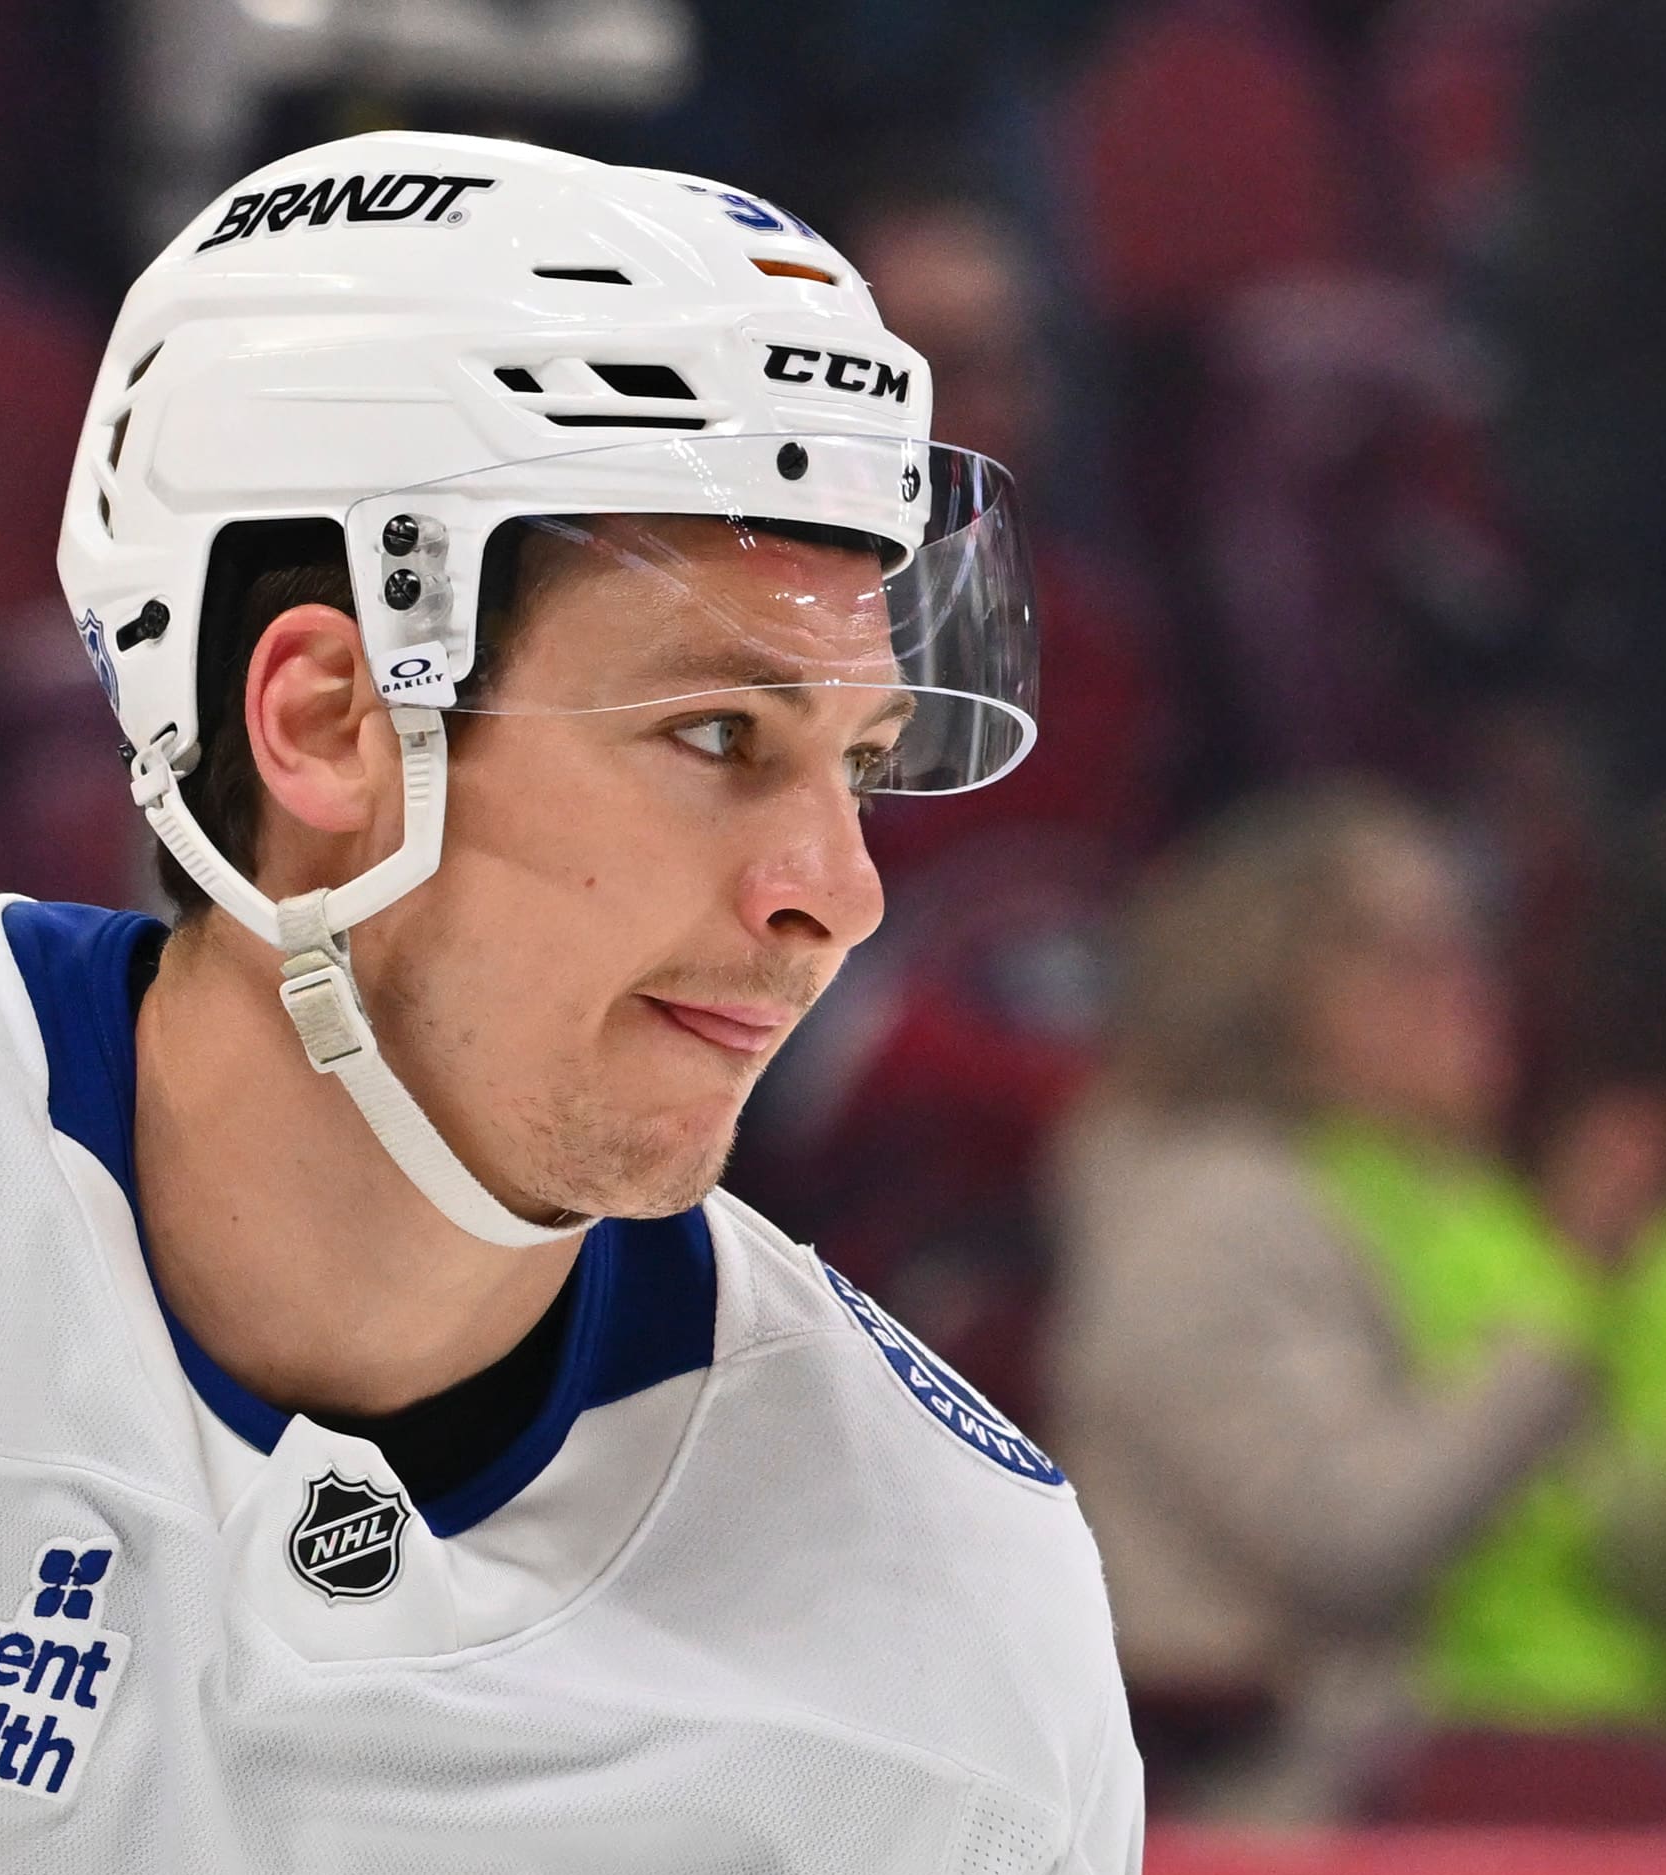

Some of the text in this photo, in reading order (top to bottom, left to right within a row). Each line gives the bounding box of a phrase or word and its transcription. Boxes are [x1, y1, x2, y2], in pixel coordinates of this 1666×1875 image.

[194, 174, 496, 254] BRANDT
[763, 343, 910, 405] CCM
[381, 673, 444, 693] OAKLEY
[309, 1521, 392, 1566] NHL
